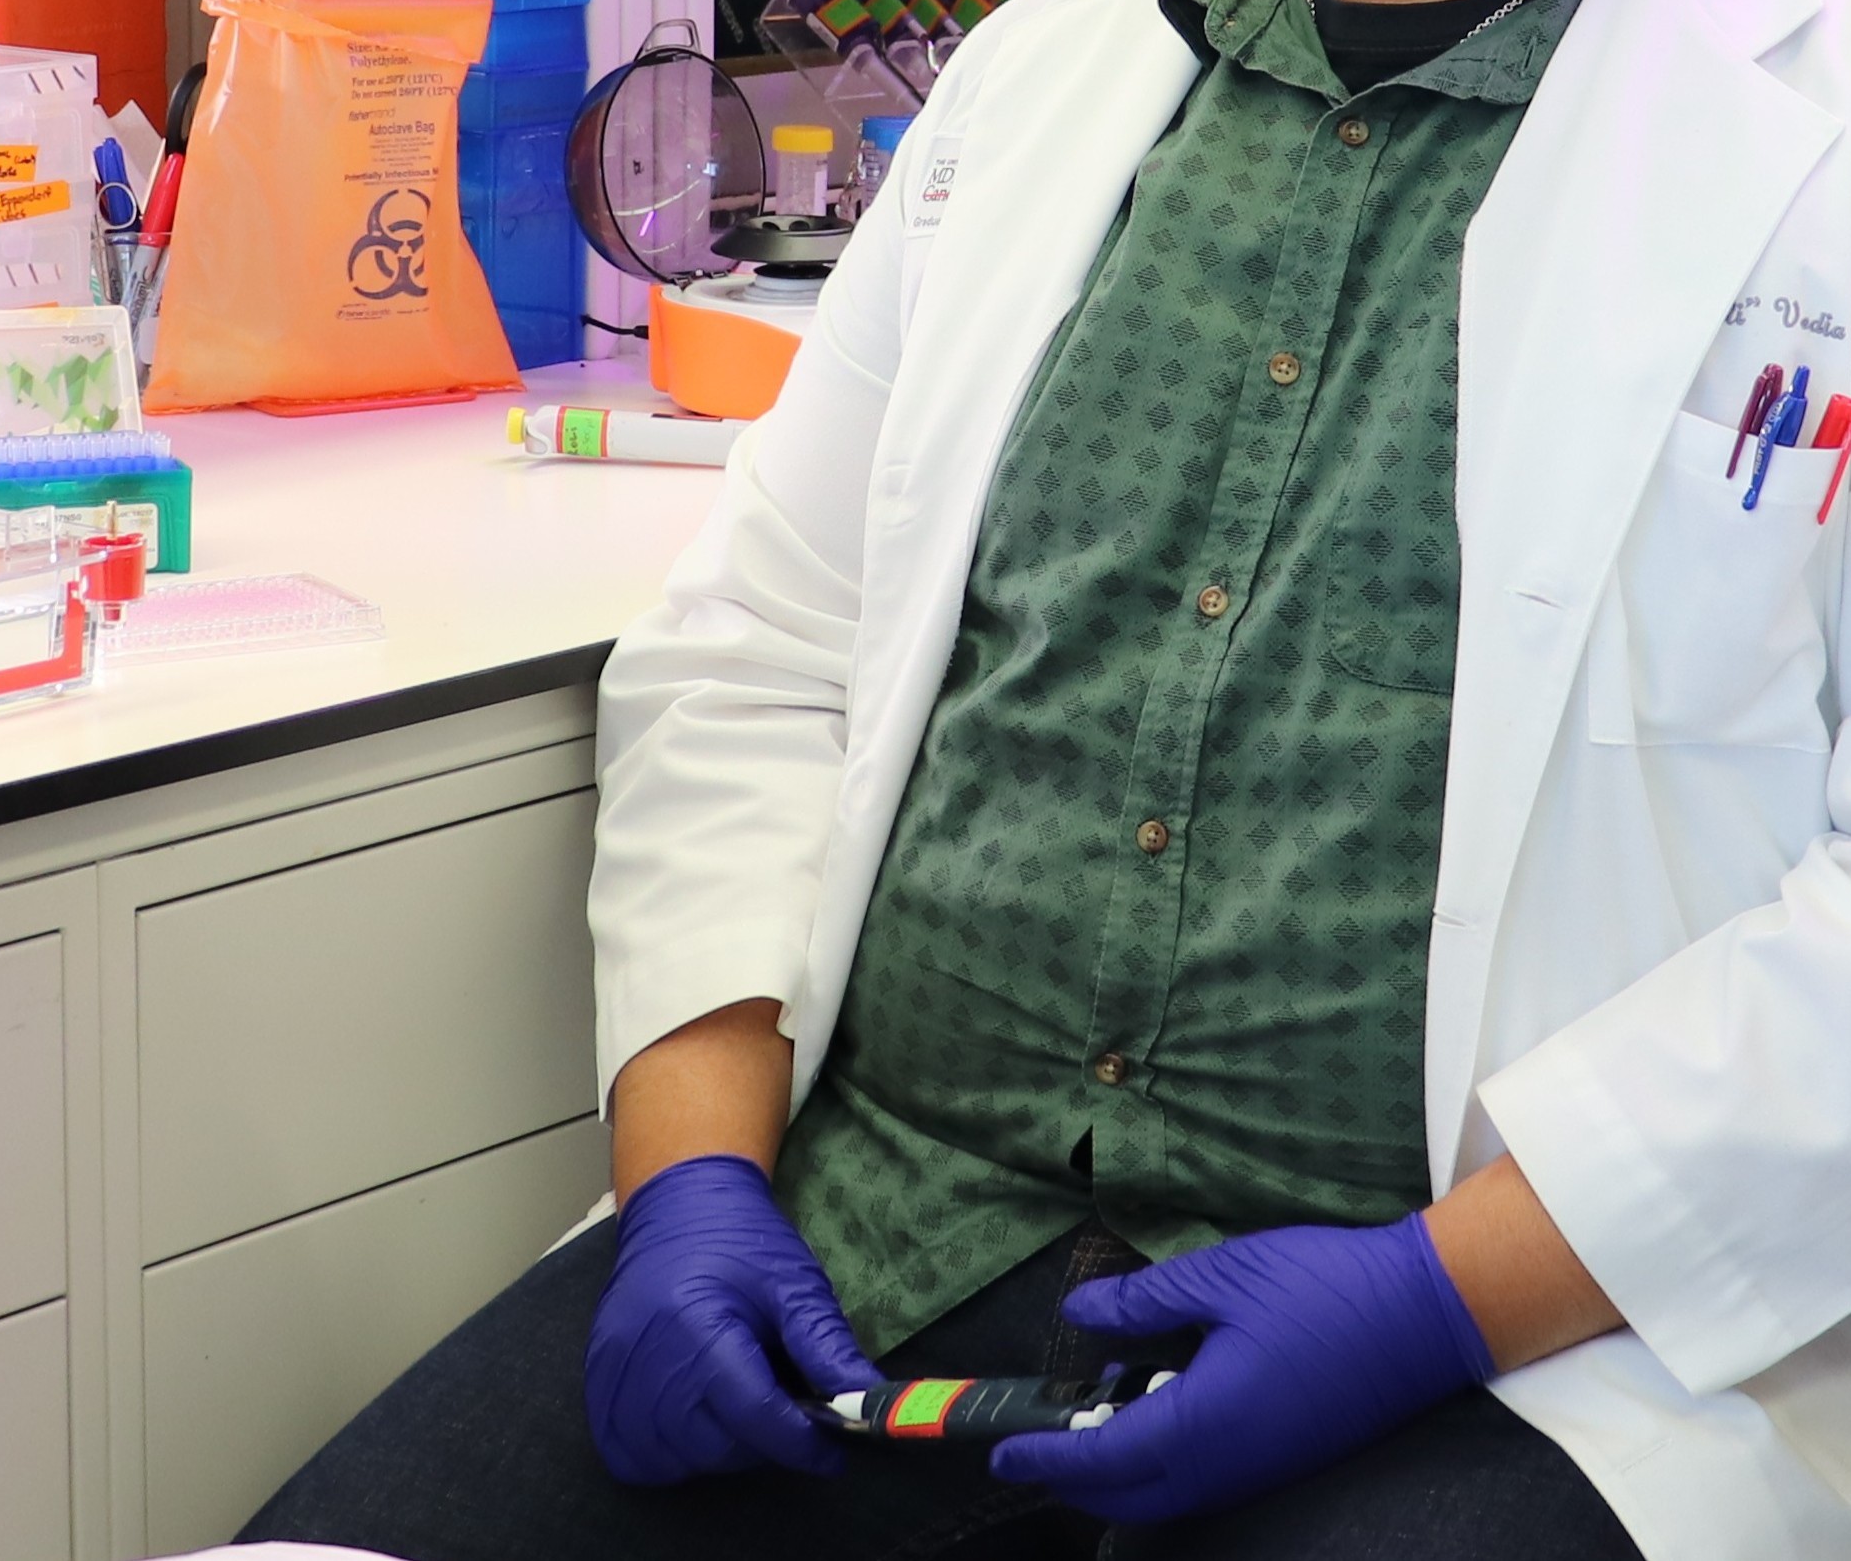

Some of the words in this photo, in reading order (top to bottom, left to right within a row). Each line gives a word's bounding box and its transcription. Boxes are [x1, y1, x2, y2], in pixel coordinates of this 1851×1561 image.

[349, 54, 412, 69] Polyethylene.
[352, 77, 365, 87] For
[351, 90, 362, 100] Do
[362, 91, 373, 99] not
[369, 123, 414, 136] Autoclave
[415, 120, 436, 135] Bag
[344, 170, 383, 181] Potentially
[384, 168, 430, 179] Infectious
[927, 167, 956, 185] MD
[1773, 296, 1847, 340] Vedia
